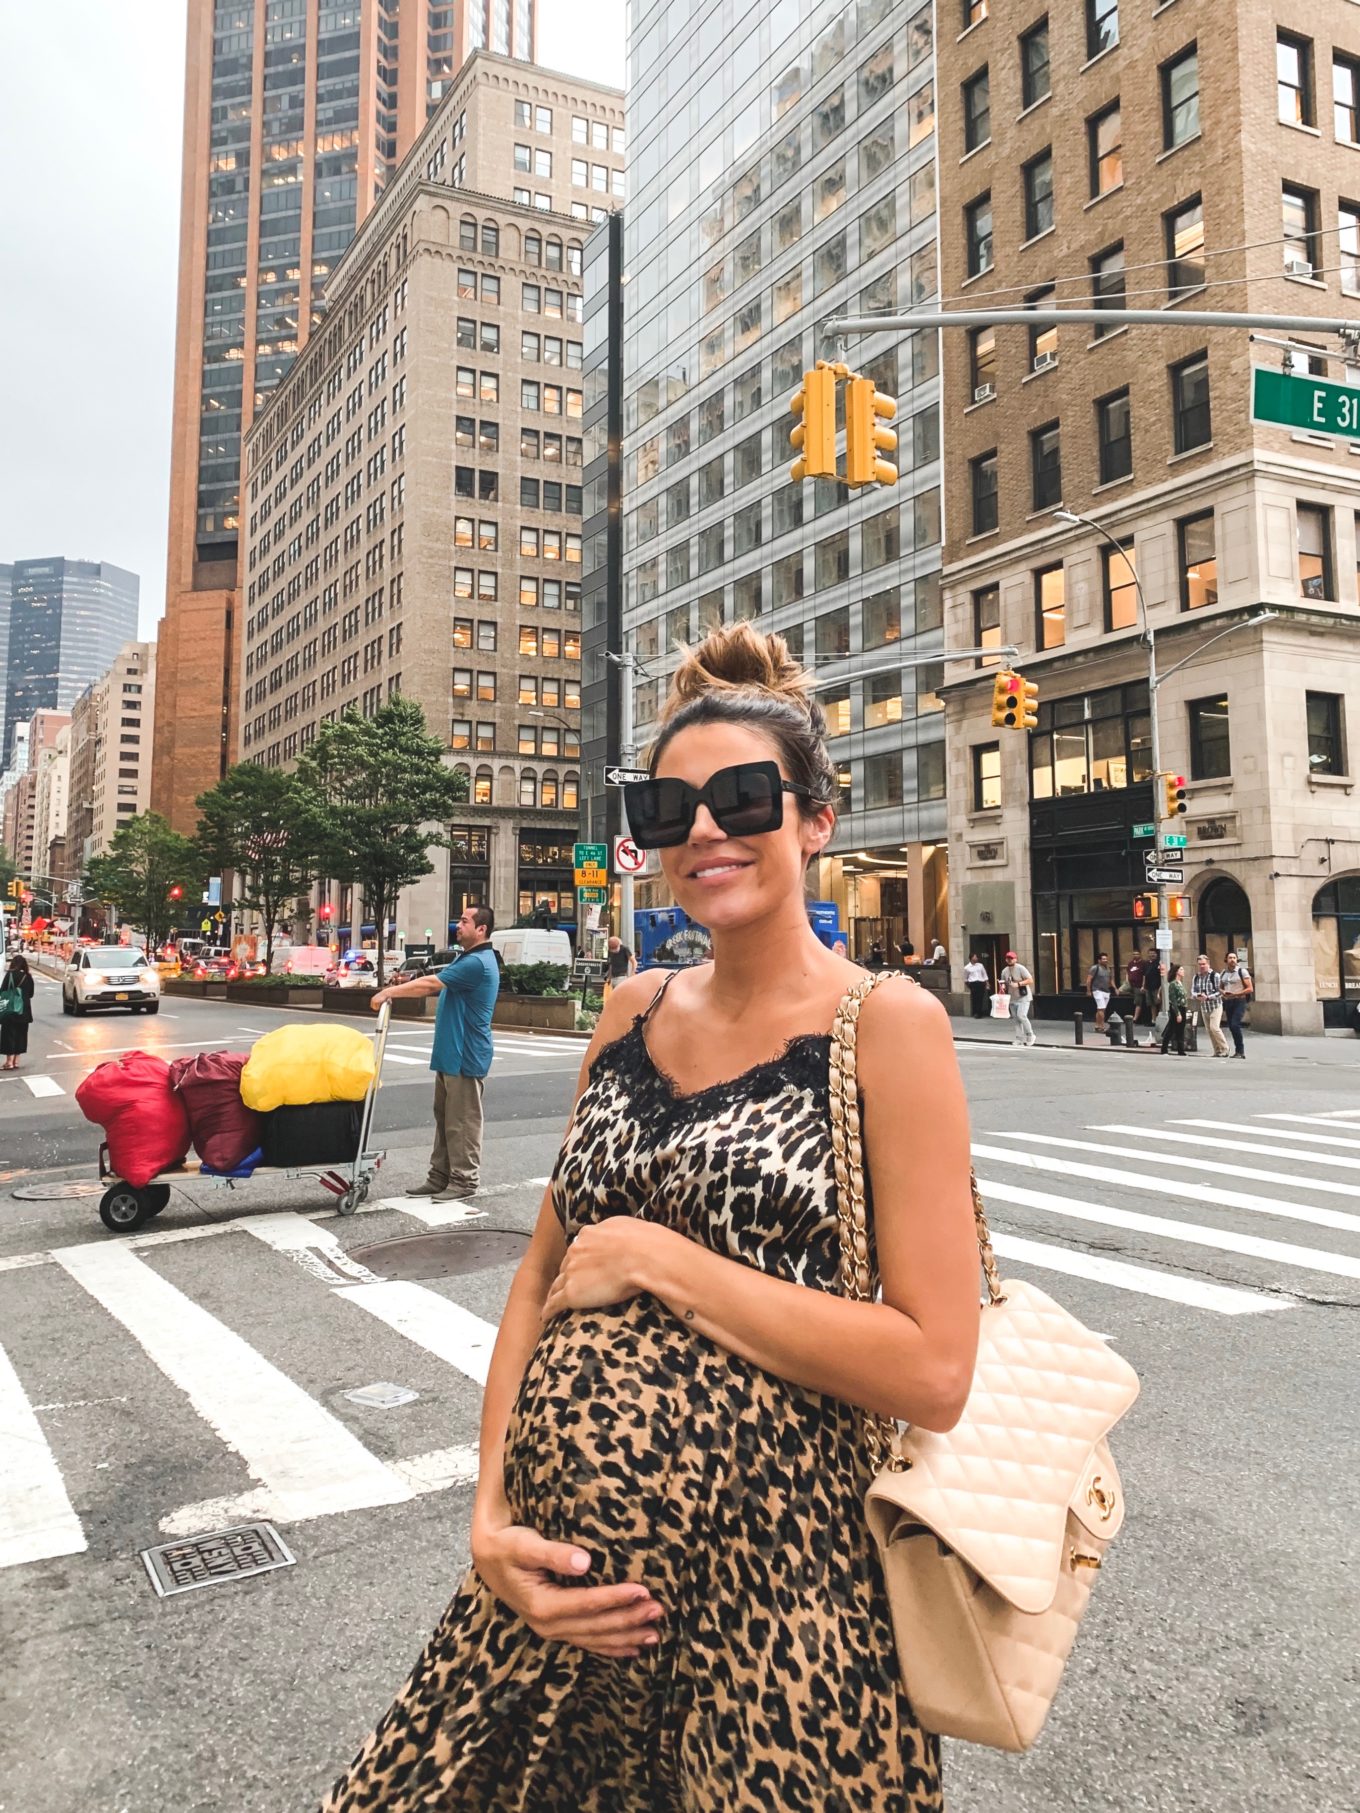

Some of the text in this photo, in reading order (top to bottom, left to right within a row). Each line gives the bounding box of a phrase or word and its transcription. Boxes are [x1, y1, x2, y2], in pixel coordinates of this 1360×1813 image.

[1313, 389, 1358, 430] E 31
[612, 773, 627, 781] ONE
[1166, 851, 1179, 860] WAY
[1152, 870, 1181, 880] ONE WAY
